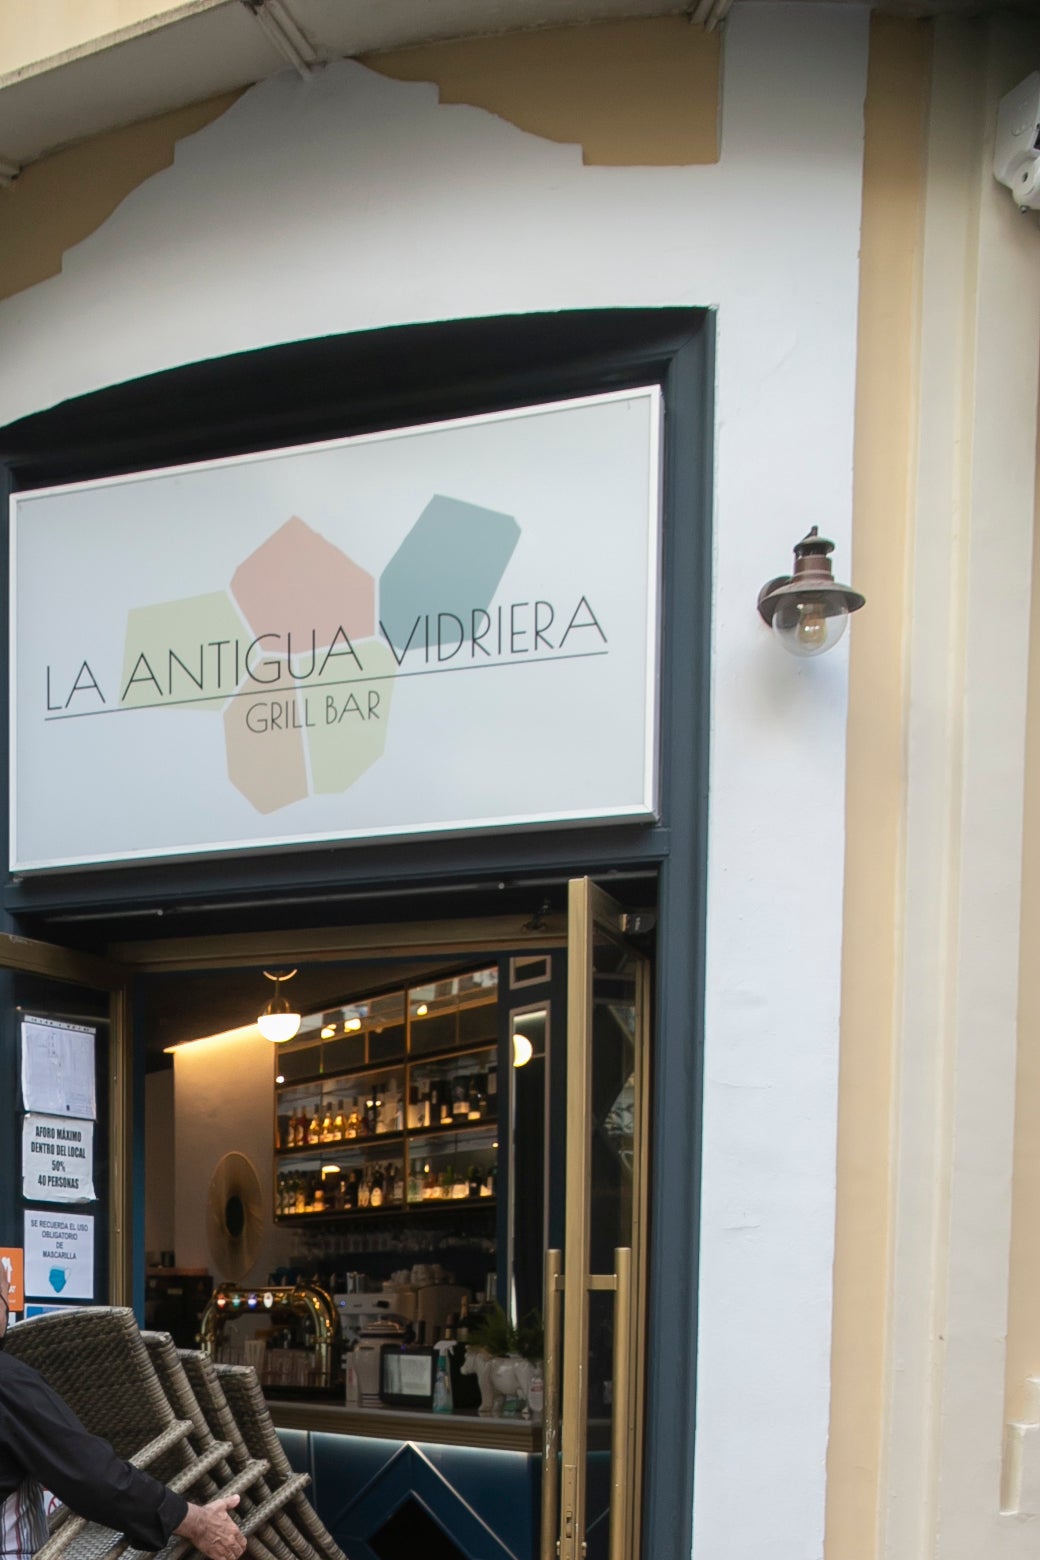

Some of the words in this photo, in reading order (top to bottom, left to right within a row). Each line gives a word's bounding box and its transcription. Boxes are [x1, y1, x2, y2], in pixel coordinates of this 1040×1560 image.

[47, 660, 106, 711] LA
[121, 625, 364, 702] ANTIGUA
[379, 595, 608, 667] VIDRIERA
[245, 698, 316, 733] GRILL
[325, 690, 380, 725] BAR
[35, 1126, 55, 1139] AFORO
[57, 1128, 81, 1142] MÁXIMO
[31, 1142, 55, 1156] DENTRO
[57, 1145, 68, 1157] DEL
[68, 1147, 86, 1159] LOCAL
[52, 1160, 65, 1172] 50%
[38, 1174, 47, 1187] 40
[48, 1176, 79, 1189] PERSONAS
[31, 1219, 39, 1228] SE
[39, 1220, 69, 1230] RECUERDA
[69, 1223, 76, 1231] EL
[77, 1223, 88, 1232] USO
[41, 1231, 78, 1241] OBLIGATORIO
[56, 1241, 63, 1250] DE
[42, 1250, 77, 1260] MASCARILLA
